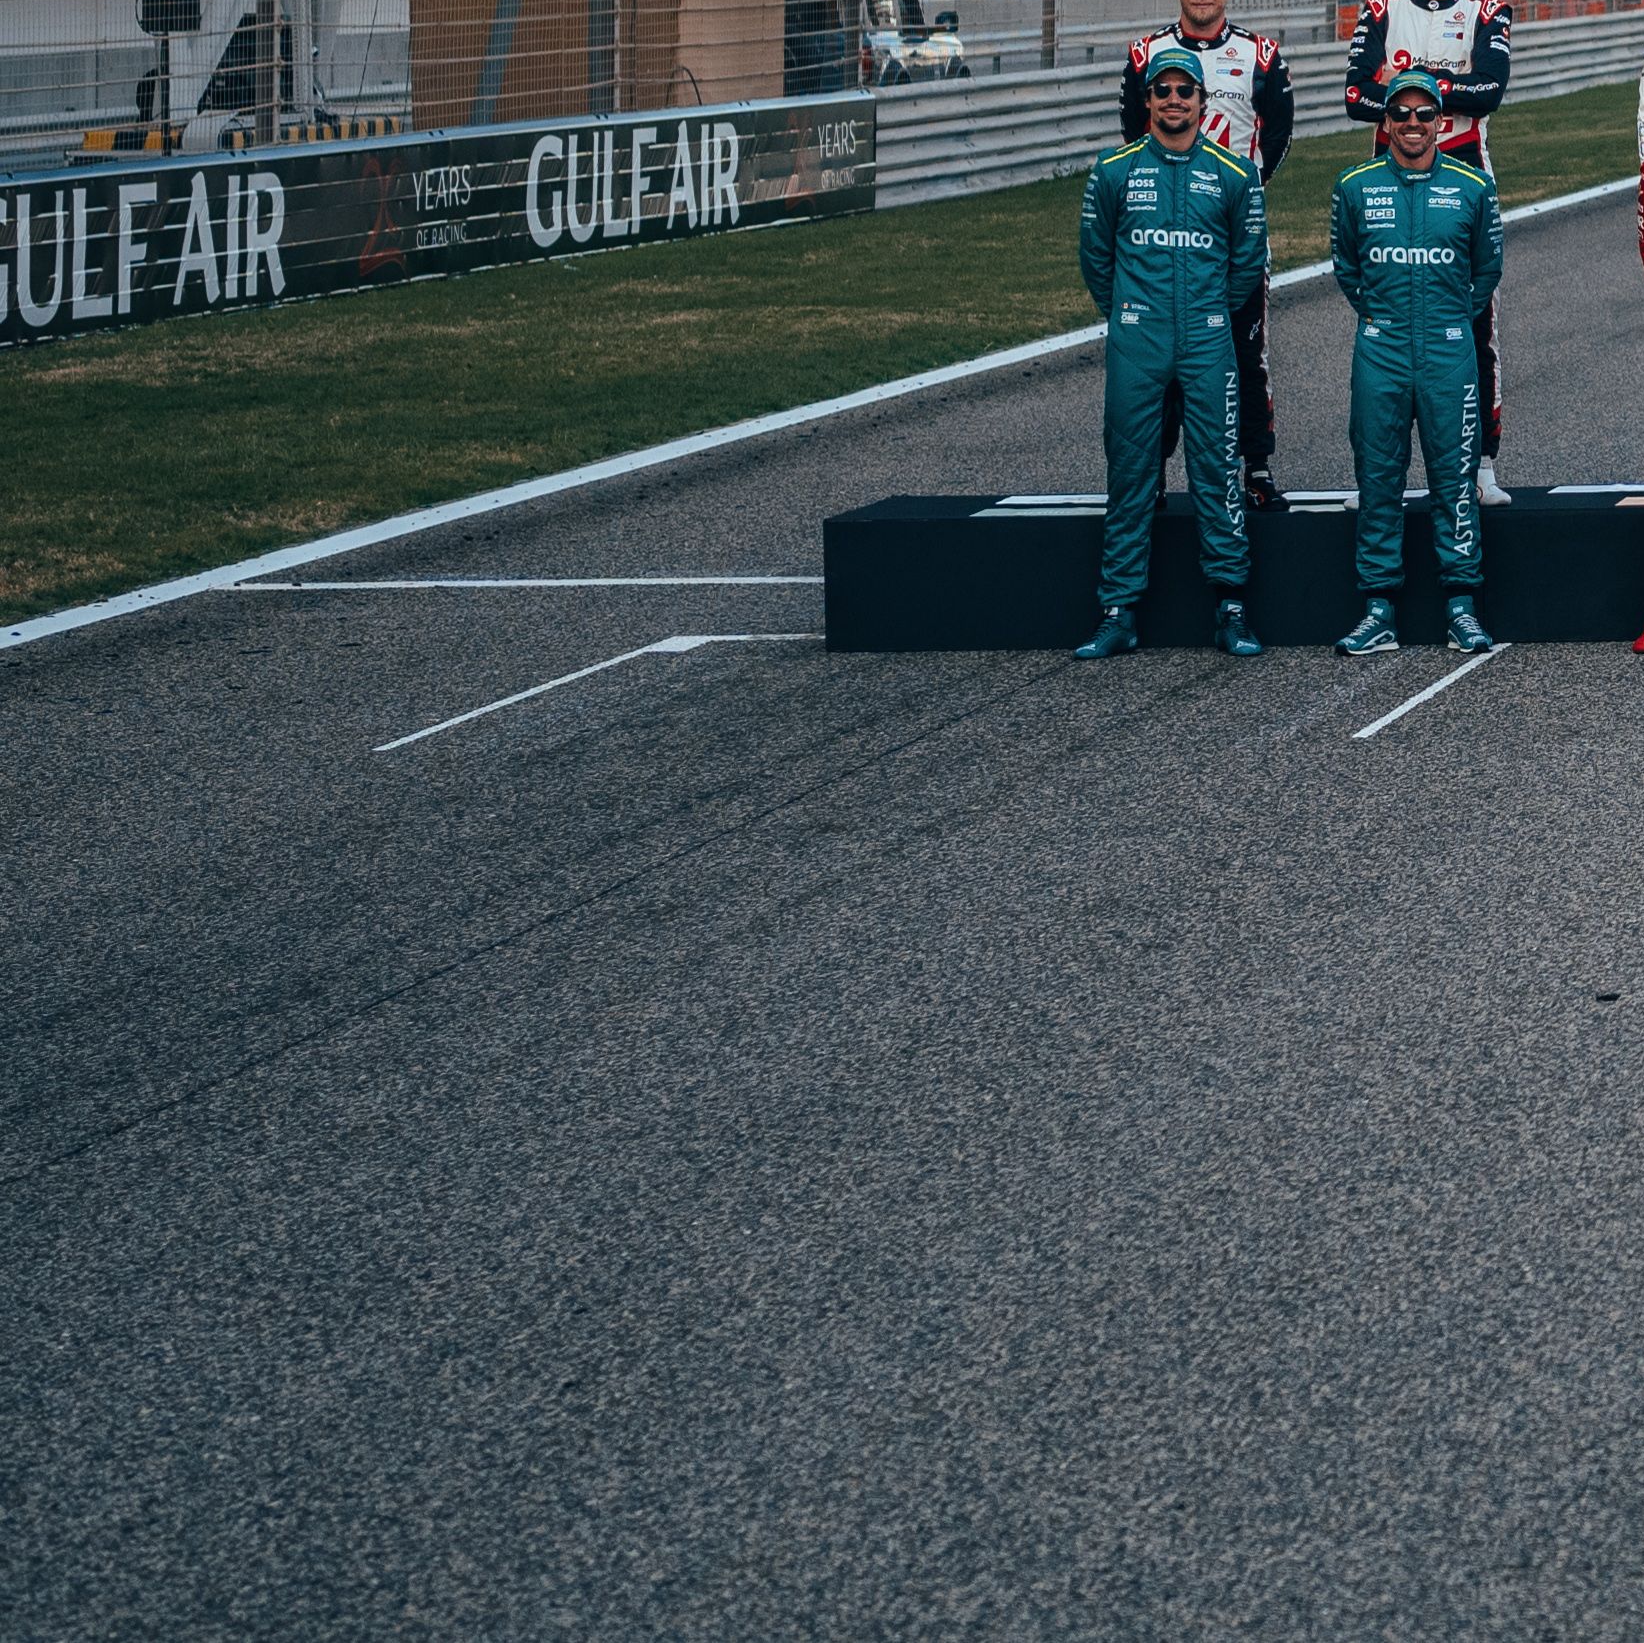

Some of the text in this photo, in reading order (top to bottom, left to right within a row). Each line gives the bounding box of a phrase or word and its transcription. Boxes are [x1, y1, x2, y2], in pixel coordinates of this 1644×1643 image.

[1412, 57, 1467, 69] MoneyGram
[1452, 82, 1500, 93] MoneyGram
[817, 119, 857, 159] YEARS
[412, 164, 472, 211] YEARS
[525, 120, 740, 249] GULF AIR
[821, 168, 856, 189] OF RACING
[1128, 179, 1155, 188] BOSS
[1190, 182, 1222, 193] aramco
[1128, 191, 1157, 201] JCB
[1362, 186, 1398, 195] cognizant
[1366, 197, 1393, 206] BOSS
[1428, 197, 1462, 206] aramco
[1366, 209, 1395, 220] JCB
[417, 222, 467, 249] OF RACING
[1131, 229, 1214, 249] aramco
[0, 171, 286, 327] ULF AIR
[1369, 247, 1456, 265] aramco
[1225, 371, 1238, 462] MARTIN
[1460, 383, 1476, 475] MARTIN
[1225, 468, 1245, 538] ASTON
[1454, 482, 1474, 557] ASTON
